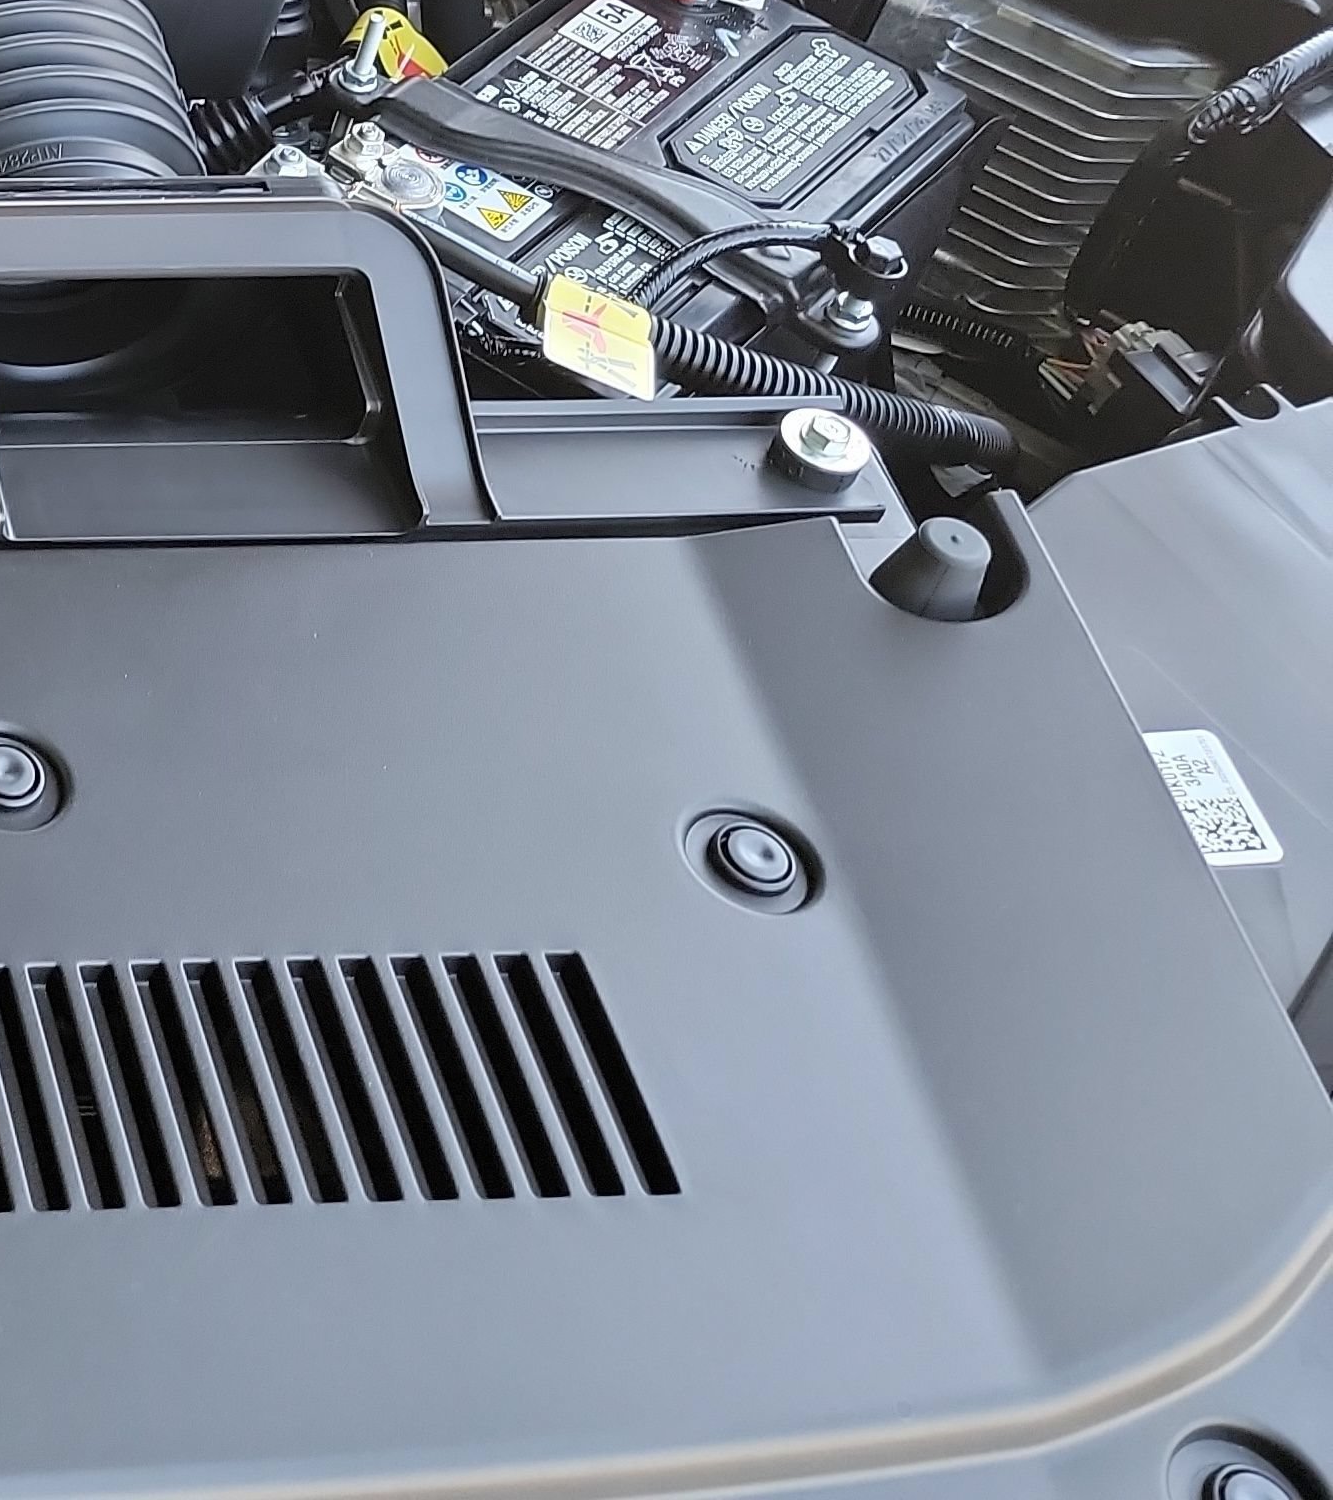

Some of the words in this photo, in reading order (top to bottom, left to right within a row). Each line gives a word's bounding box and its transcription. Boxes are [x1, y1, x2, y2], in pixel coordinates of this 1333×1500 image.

[596, 2, 633, 24] 5A
[699, 110, 733, 148] DANGER
[735, 83, 771, 115] POISON
[553, 231, 594, 269] POISON
[1192, 758, 1214, 775] A2
